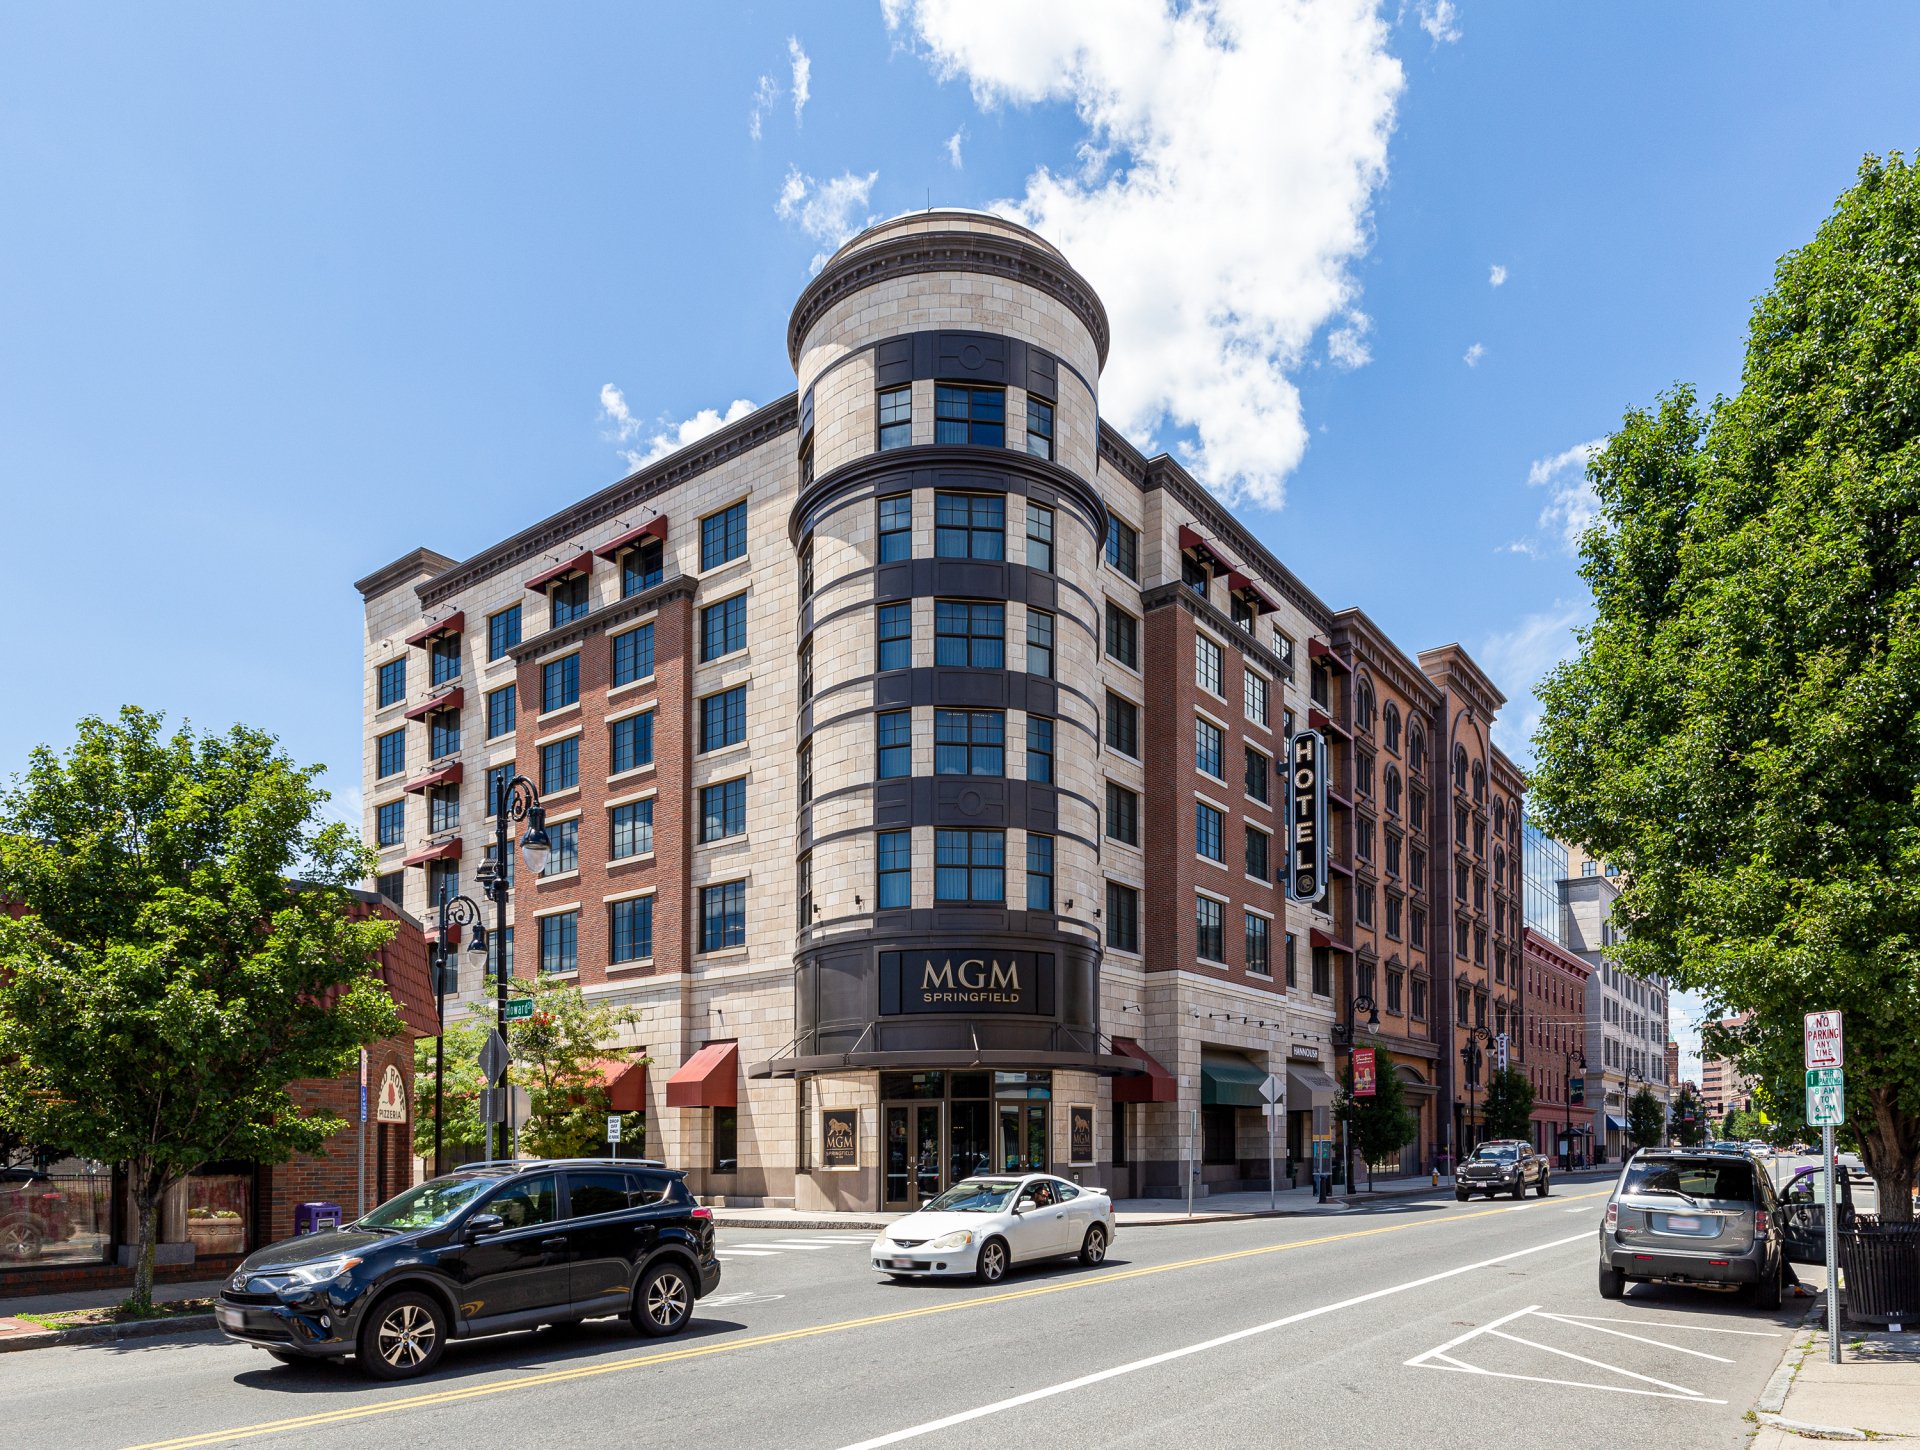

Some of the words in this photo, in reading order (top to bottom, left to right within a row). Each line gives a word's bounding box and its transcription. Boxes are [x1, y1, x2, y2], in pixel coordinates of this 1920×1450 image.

[1295, 740, 1313, 870] HOTEL
[921, 959, 1022, 989] MGM
[923, 992, 1019, 1002] SPRINGFIELD
[1816, 1016, 1829, 1027] NO
[1807, 1028, 1839, 1040] PARKING
[1293, 1046, 1317, 1058] HANNOUSH
[379, 1109, 401, 1119] PIZZERIA
[827, 1136, 853, 1148] MGM
